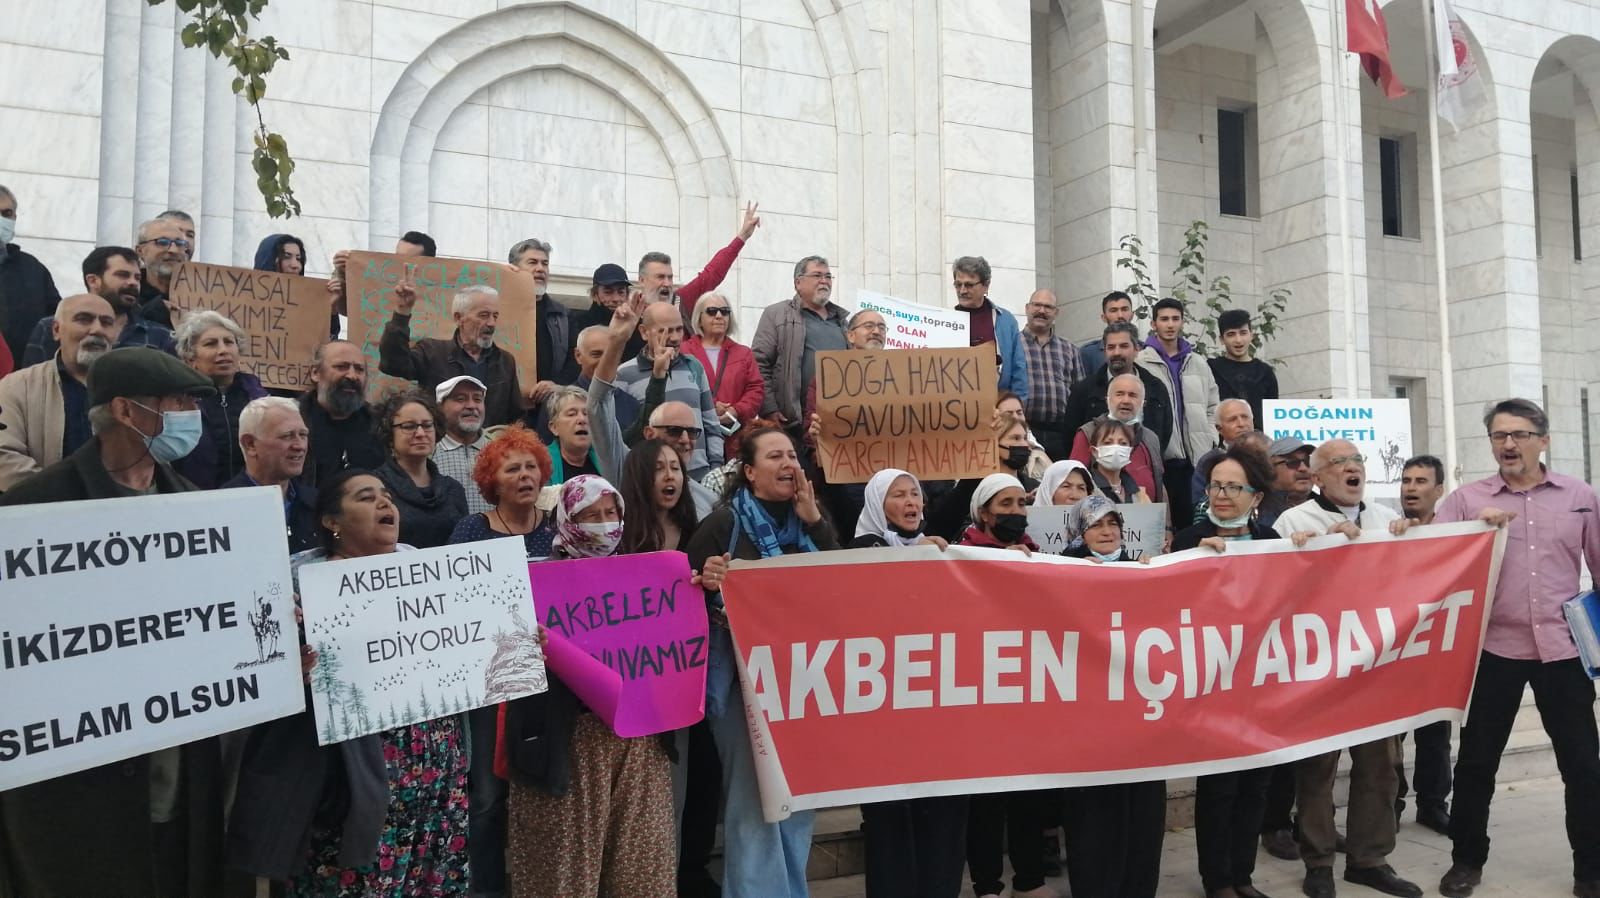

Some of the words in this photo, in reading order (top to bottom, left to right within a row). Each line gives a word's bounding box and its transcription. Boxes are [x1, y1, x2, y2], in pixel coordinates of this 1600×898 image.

[174, 263, 298, 306] ANAYASAL
[240, 332, 289, 361] ENİ
[896, 325, 927, 338] OLAN
[821, 356, 899, 399] DOĞA
[908, 356, 981, 395] HAKKI
[833, 400, 980, 439] SAVUNUSU
[1274, 405, 1373, 420] DOĞANIN
[1274, 426, 1375, 441] MALİYETİ
[0, 526, 231, 580] KİZKÖY'DEN
[338, 560, 441, 596] AKBELEN
[447, 549, 493, 582] İÇİN
[396, 593, 449, 622] İNAT
[546, 578, 684, 638] AKBELEN
[3, 602, 238, 670] İKİZDERE'YE
[366, 620, 486, 664] EDİYORUZ
[747, 631, 1080, 722] AKBELEN
[1107, 608, 1244, 721] İÇİN
[1252, 590, 1475, 687] ADALET
[0, 702, 132, 762] SELAM
[144, 673, 260, 724] OLSUN
